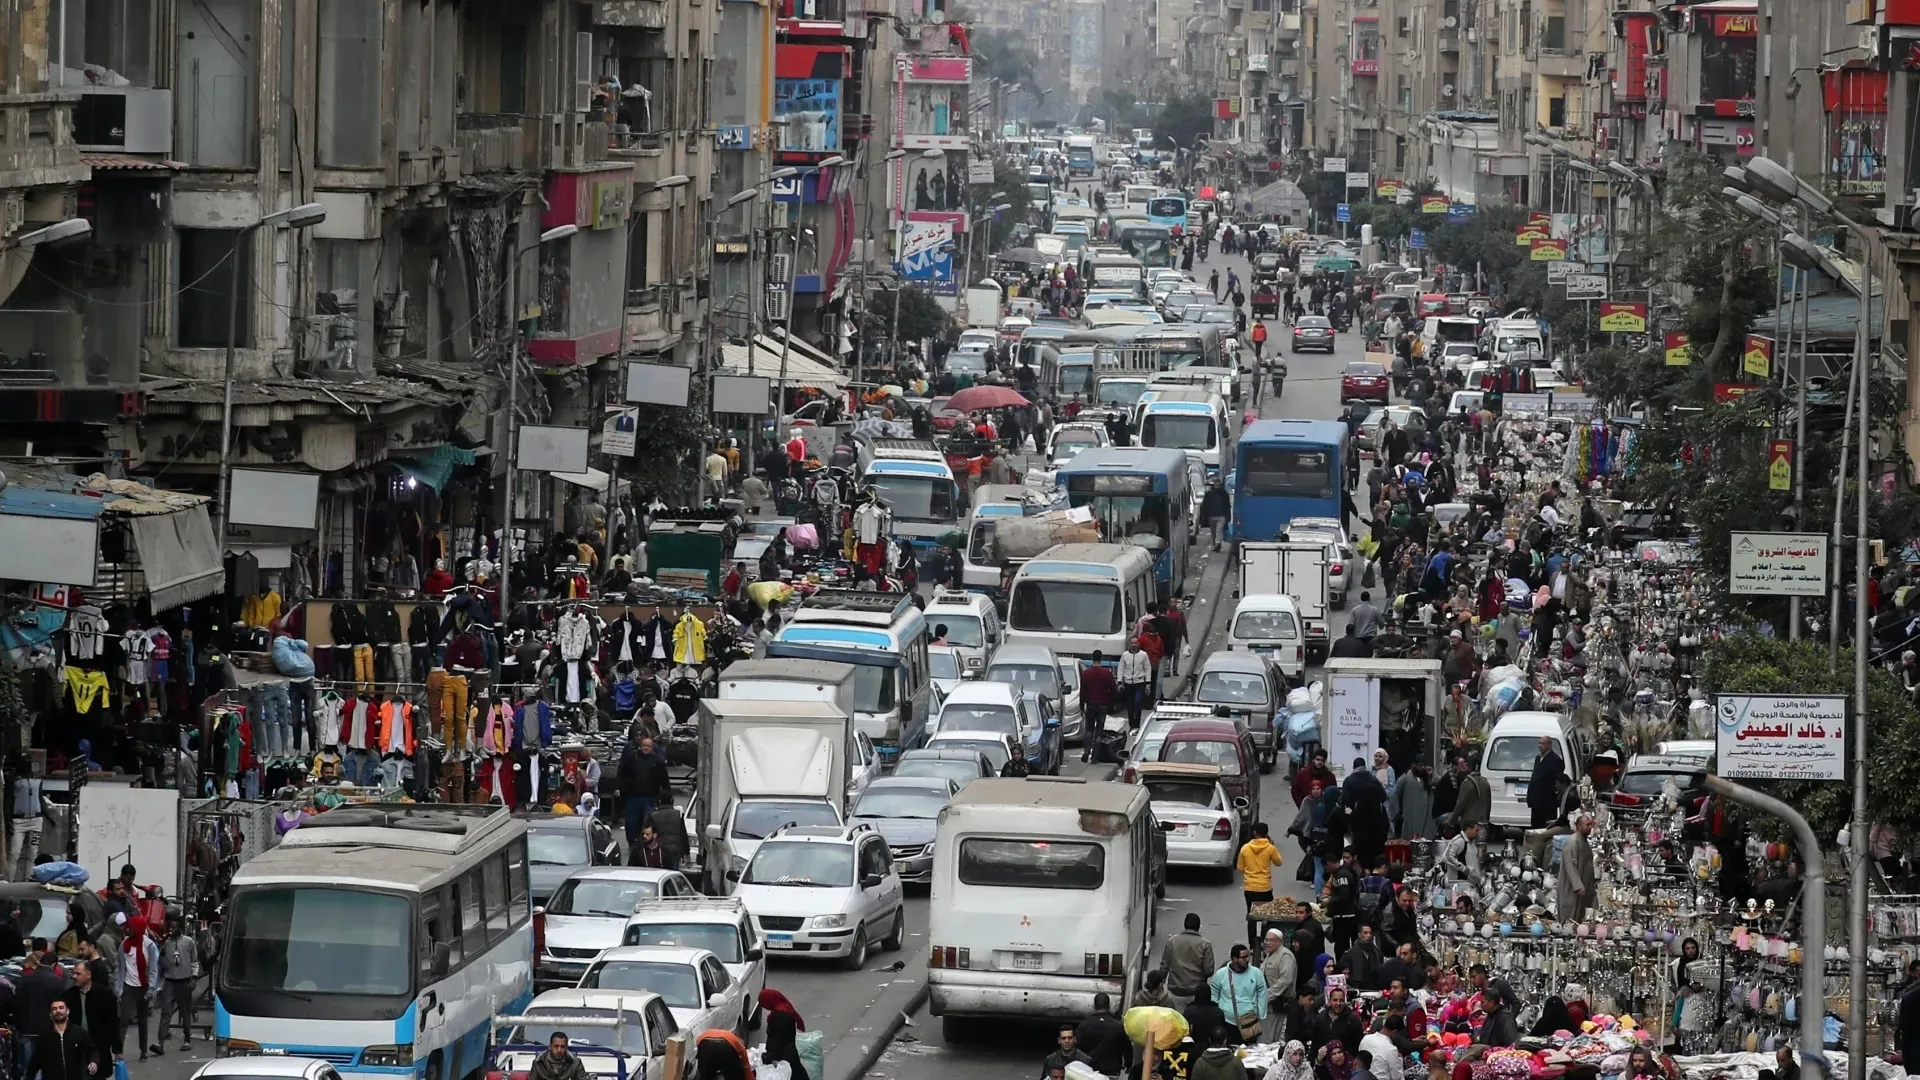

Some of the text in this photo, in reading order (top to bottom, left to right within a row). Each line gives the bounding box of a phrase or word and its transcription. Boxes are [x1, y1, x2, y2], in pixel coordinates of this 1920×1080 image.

[1757, 546, 1787, 558] الشروق
[1787, 546, 1819, 559] أكاديمية
[1751, 563, 1772, 572] إعلام
[1780, 563, 1806, 571] هندسة
[79, 621, 92, 639] 10
[1773, 700, 1821, 709] المرأة والرجل
[1750, 711, 1843, 720] للخصوبة والصحة الزوجية
[1797, 720, 1826, 739] خالد
[1727, 770, 1773, 778] 01099243232
[1778, 771, 1825, 779] 01223777590
